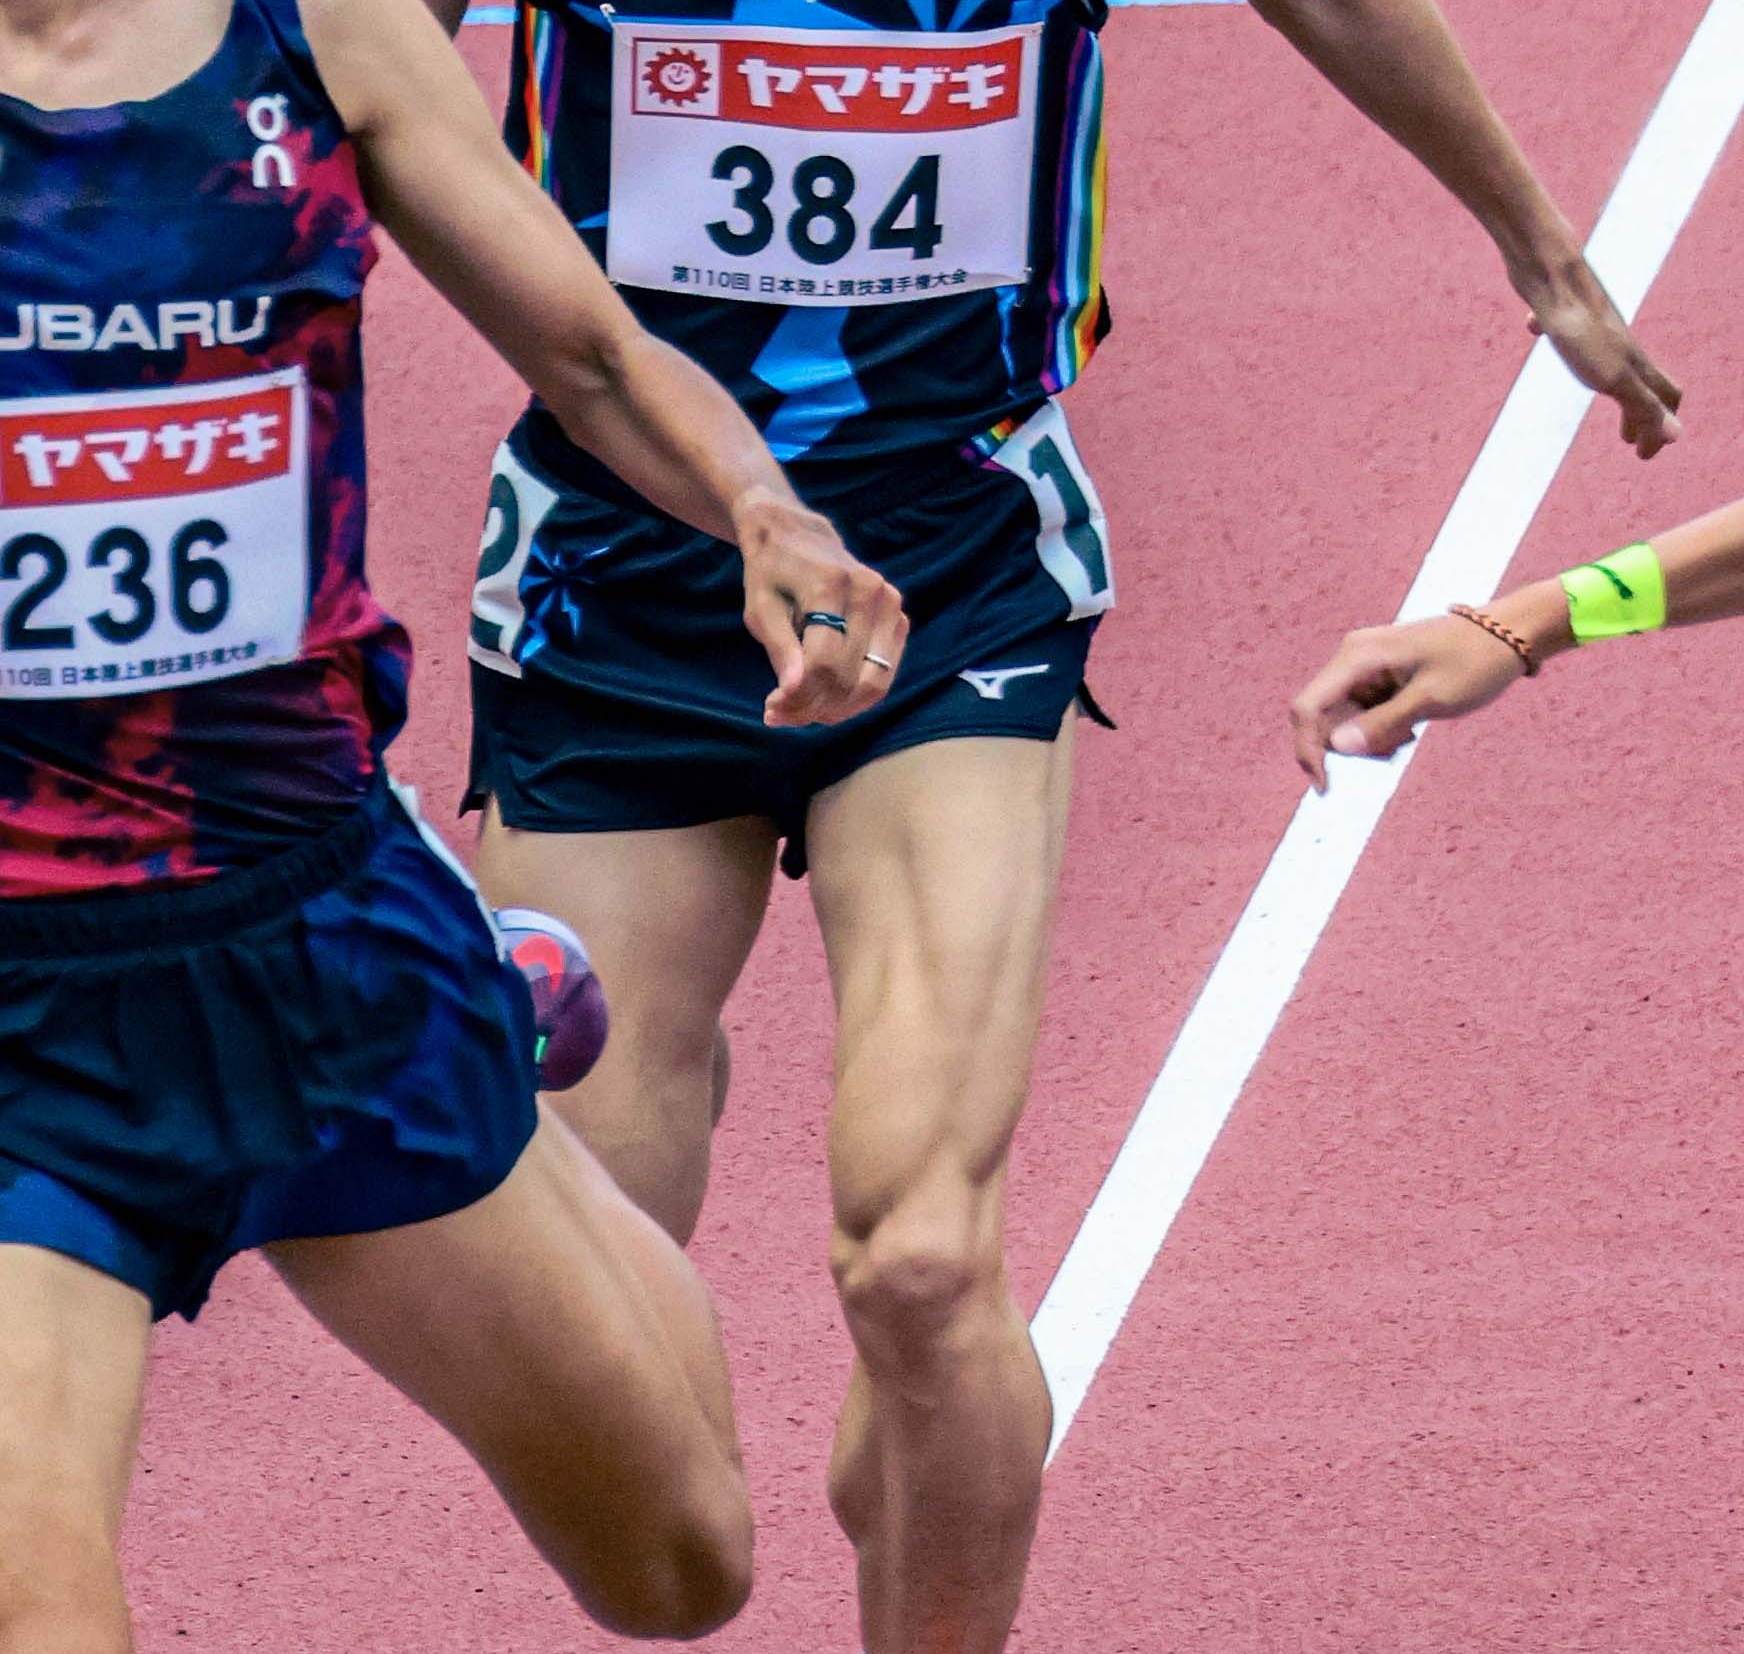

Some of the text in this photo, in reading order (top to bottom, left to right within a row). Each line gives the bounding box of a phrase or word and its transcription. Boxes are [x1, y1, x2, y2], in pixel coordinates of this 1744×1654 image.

[738, 58, 1006, 115] ヤマザキ
[705, 145, 943, 265] 384
[671, 265, 968, 297] 第110回 日本陸上競技選手権大会
[13, 412, 281, 488] ヤマザキ
